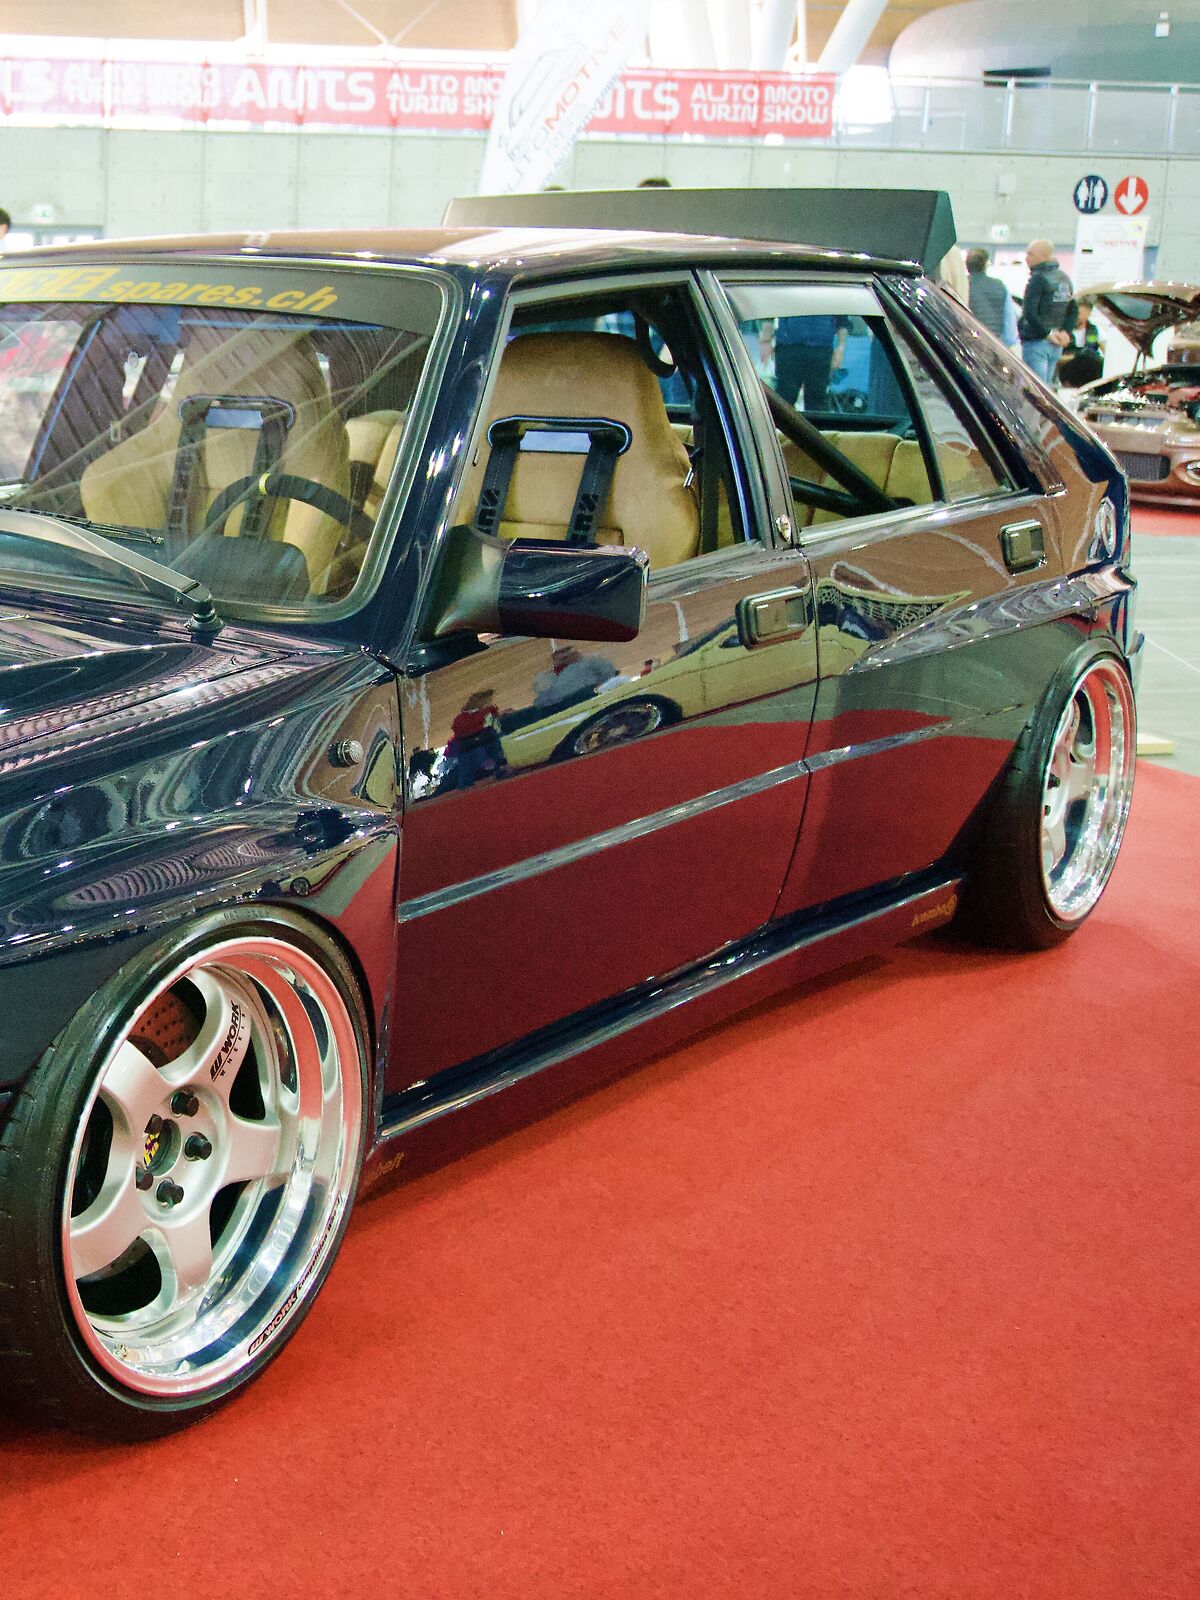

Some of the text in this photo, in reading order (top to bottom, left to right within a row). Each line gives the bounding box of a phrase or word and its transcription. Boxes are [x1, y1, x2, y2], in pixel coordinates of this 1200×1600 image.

[230, 68, 376, 112] AMTS
[386, 73, 504, 97] AUTO MO
[597, 79, 680, 121] MTS
[690, 82, 829, 105] AUTO MOTO
[387, 94, 458, 114] TURIN
[689, 103, 829, 124] TURIN SHOW
[102, 279, 339, 313] spares.ch
[221, 1000, 240, 1054] WORK
[263, 1294, 298, 1337] WORK
